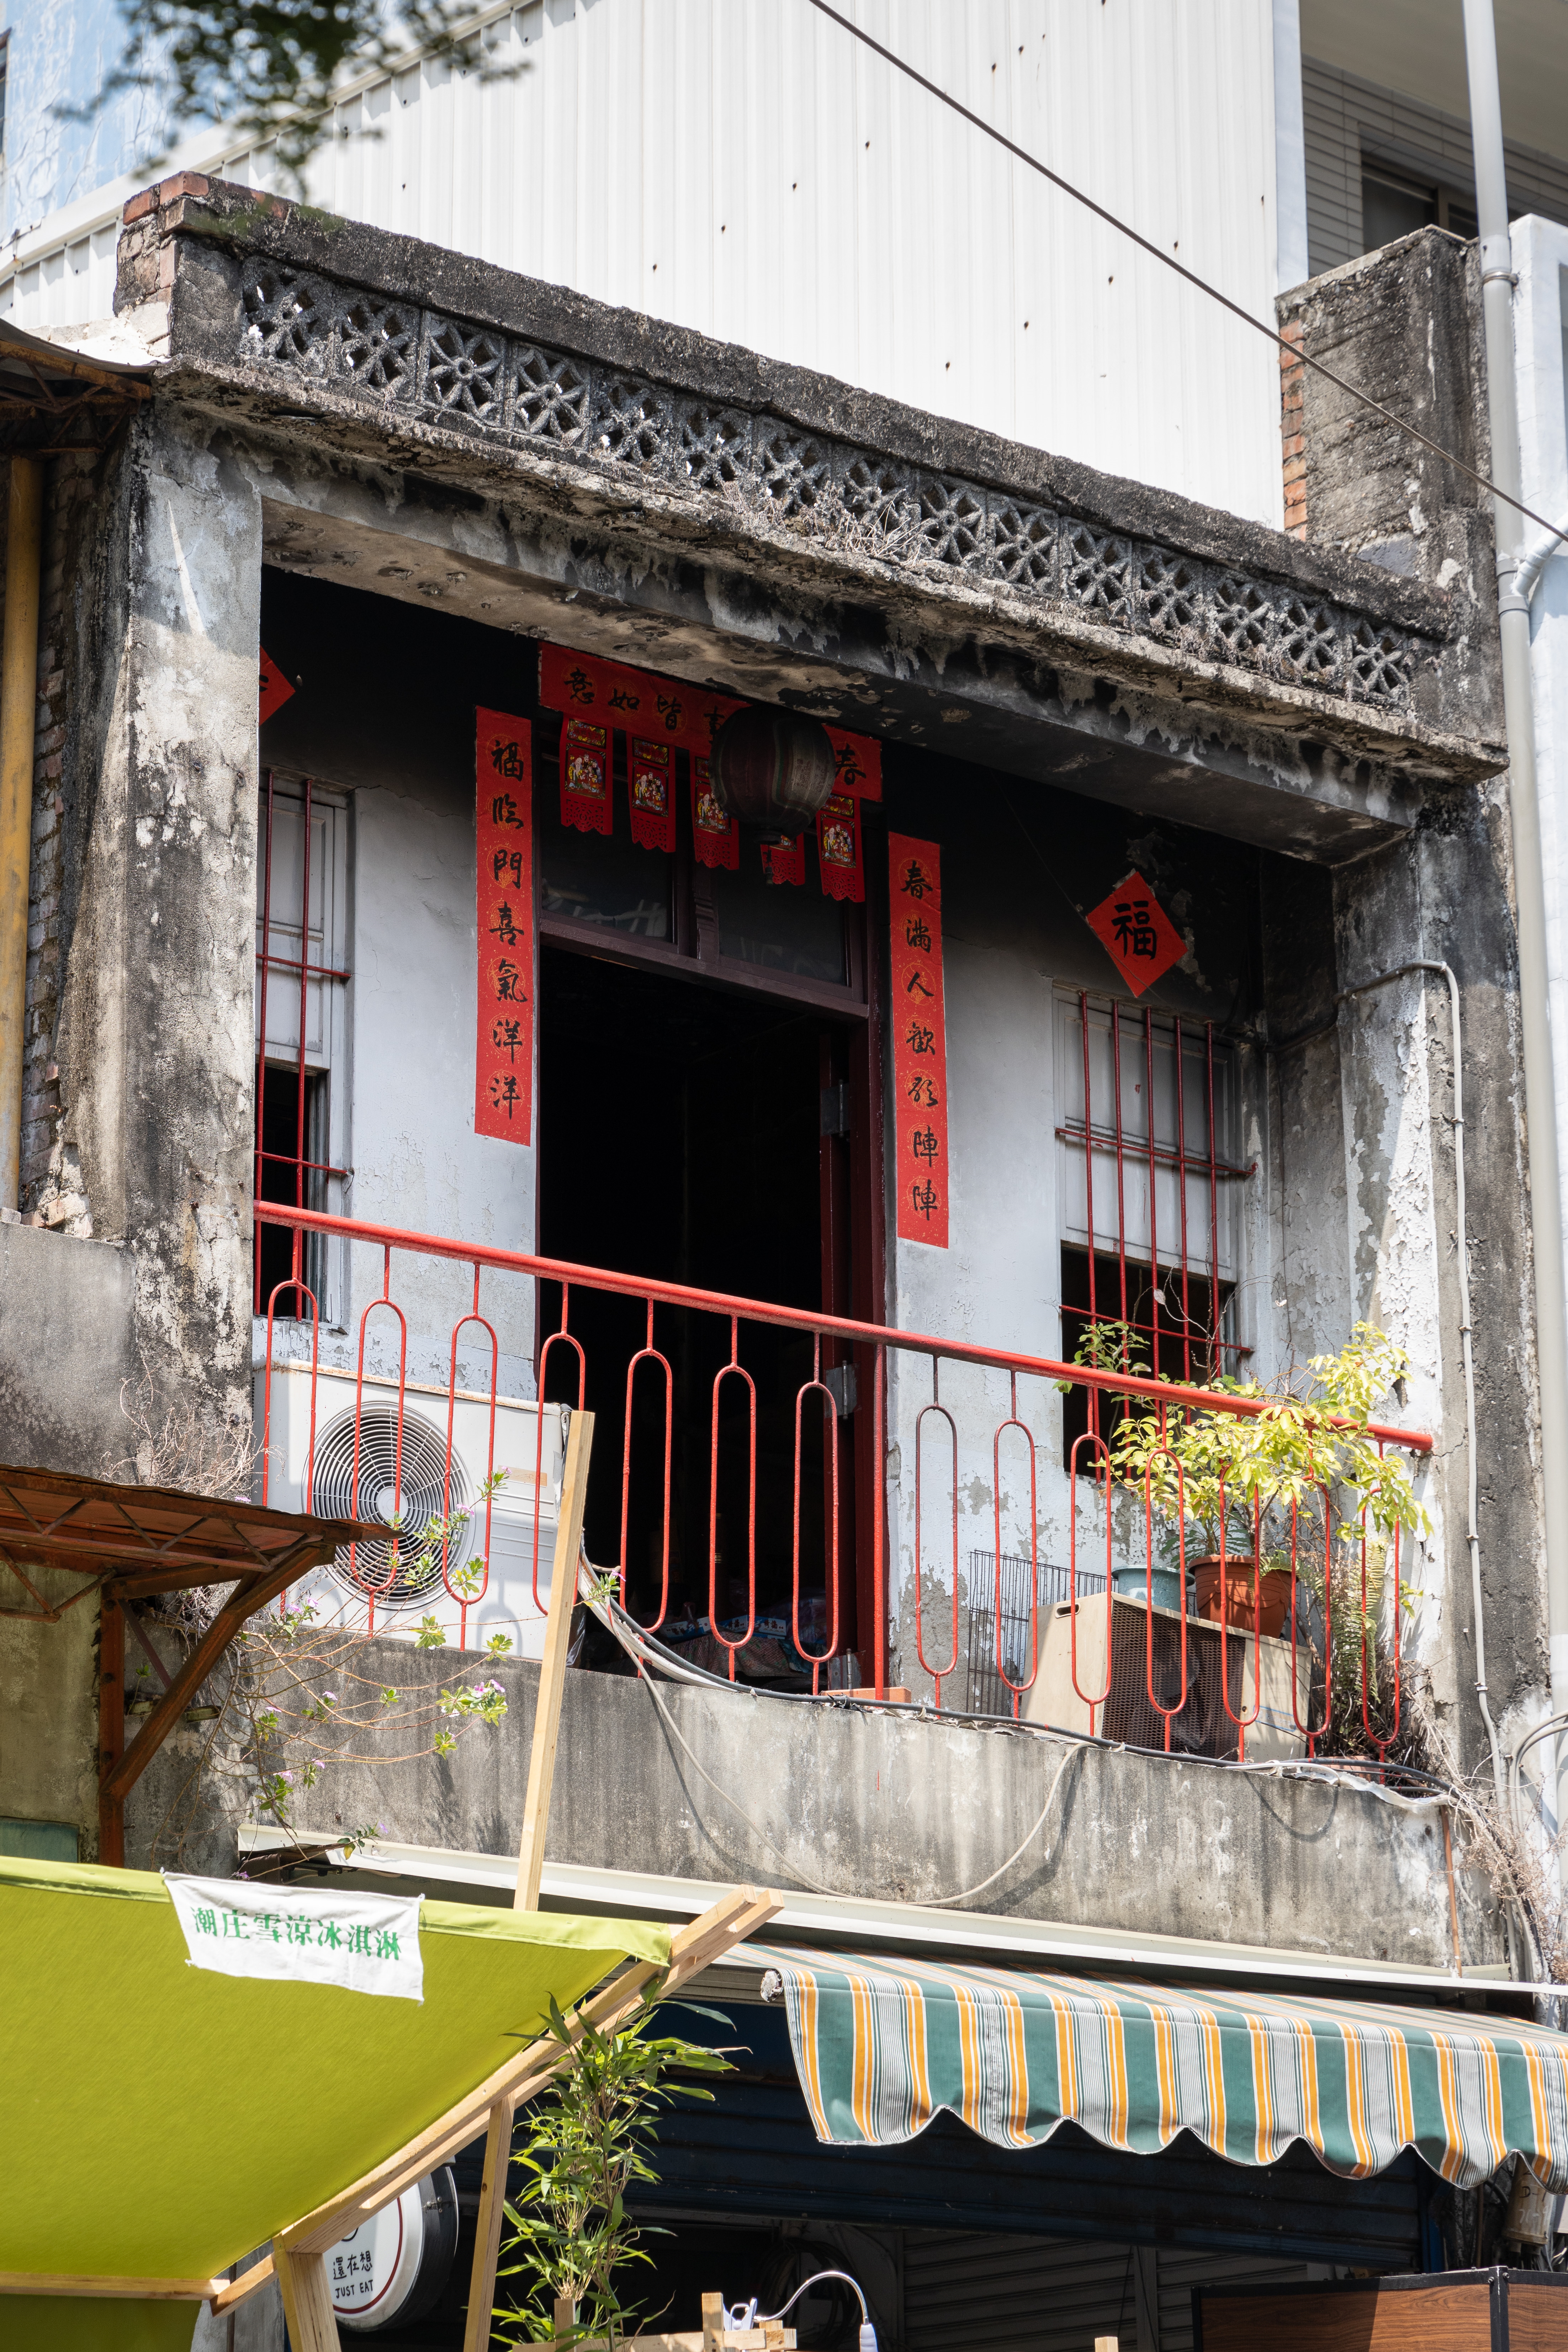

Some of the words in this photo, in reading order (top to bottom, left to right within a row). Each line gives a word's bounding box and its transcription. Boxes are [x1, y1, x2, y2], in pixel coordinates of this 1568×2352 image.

[489, 740, 528, 1120] 福臨門喜氣洋洋
[1111, 900, 1157, 960] 福
[190, 1906, 402, 1960] 潮庄雪涼冰淇淋
[333, 2250, 373, 2280] 還在想
[335, 2284, 355, 2299] JUST
[360, 2279, 374, 2293] EAT
